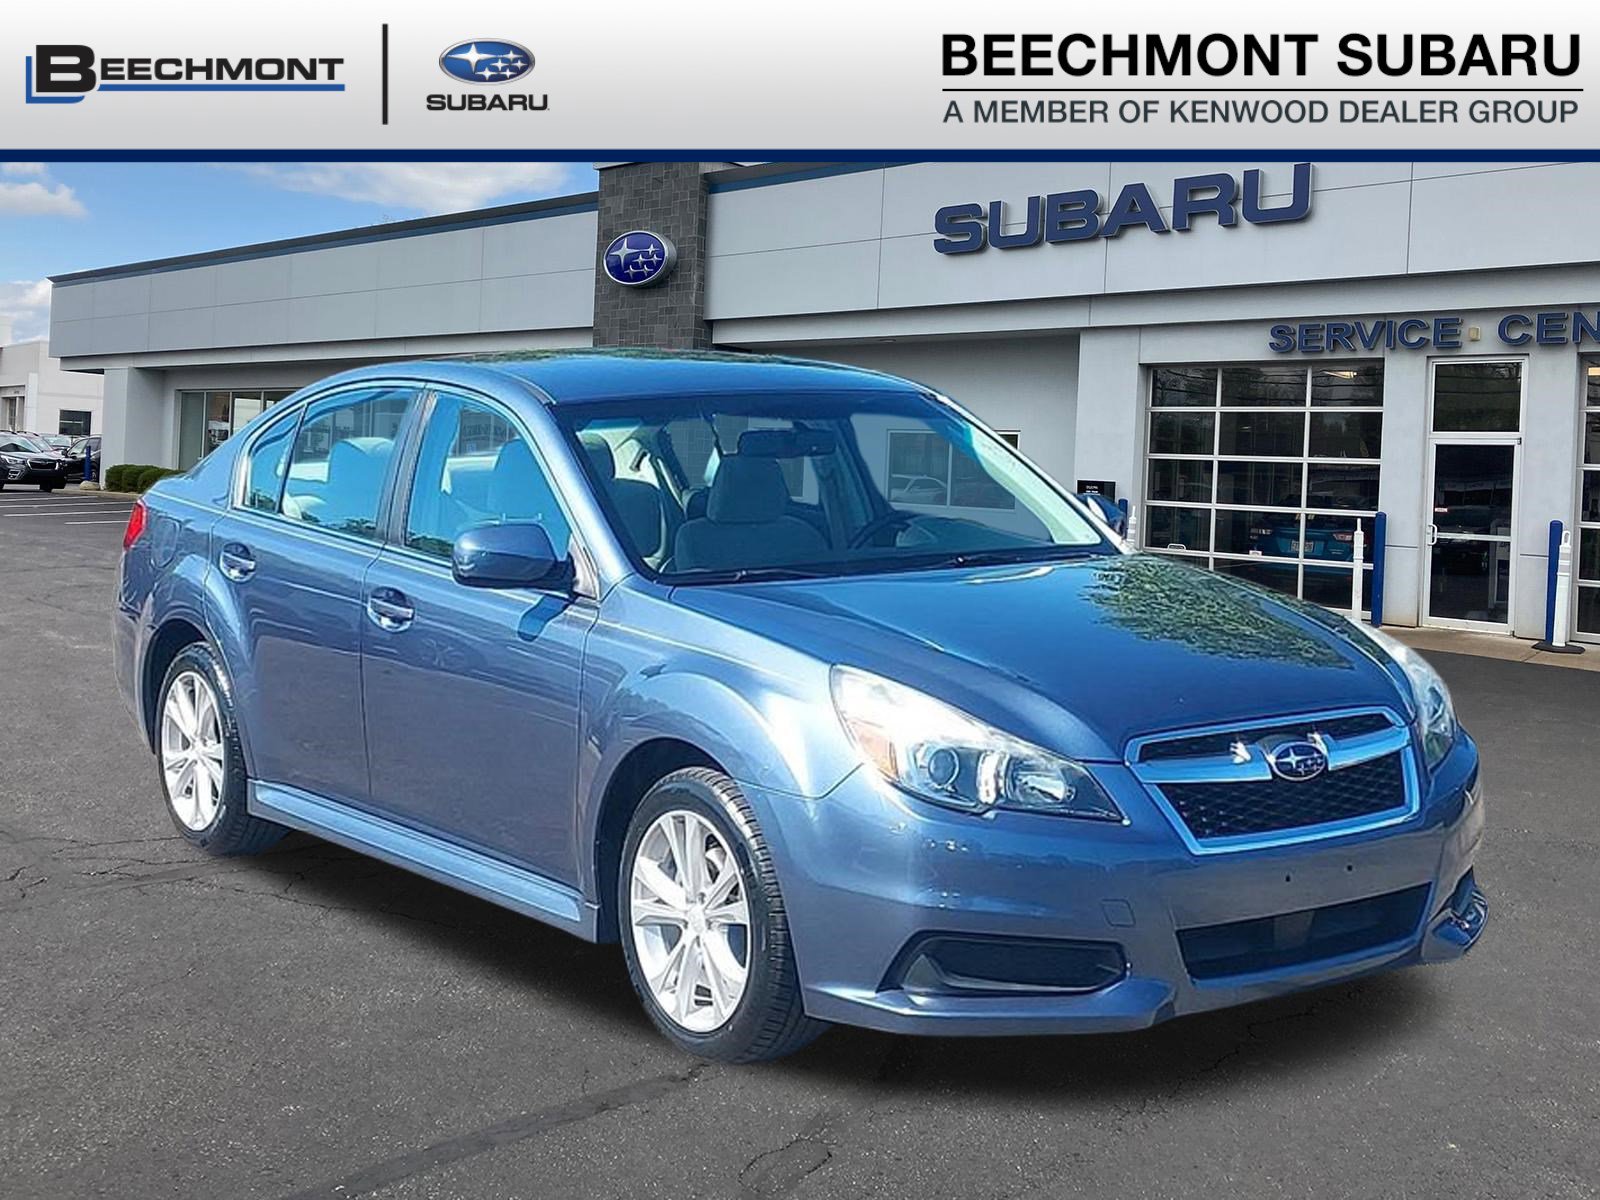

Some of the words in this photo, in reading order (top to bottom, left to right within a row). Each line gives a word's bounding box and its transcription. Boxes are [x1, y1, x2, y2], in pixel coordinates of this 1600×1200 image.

[933, 162, 1316, 256] SUBARU
[1268, 317, 1464, 353] SERVICE
[1497, 309, 1600, 347] CEN
